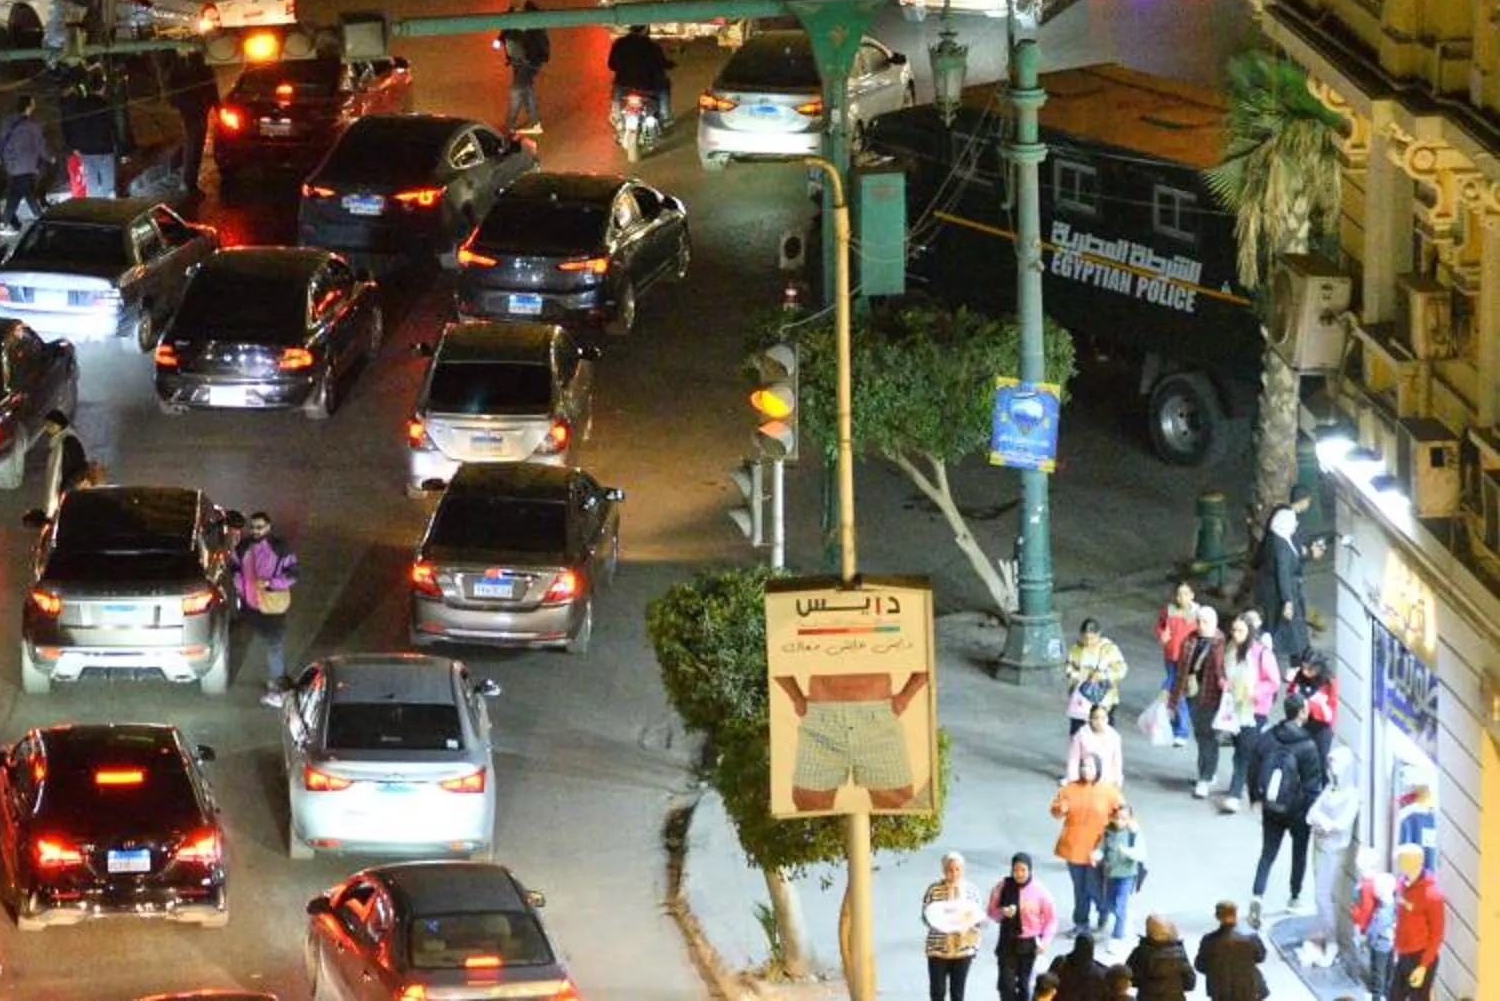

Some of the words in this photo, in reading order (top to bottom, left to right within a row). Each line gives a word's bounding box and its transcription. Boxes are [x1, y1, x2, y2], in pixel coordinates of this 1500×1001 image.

[1051, 220, 1130, 264] المصرية
[1129, 242, 1202, 284] الشرطة
[1051, 253, 1133, 296] EGYPTIAN
[1135, 277, 1198, 313] POLICE
[795, 596, 901, 618] دايس
